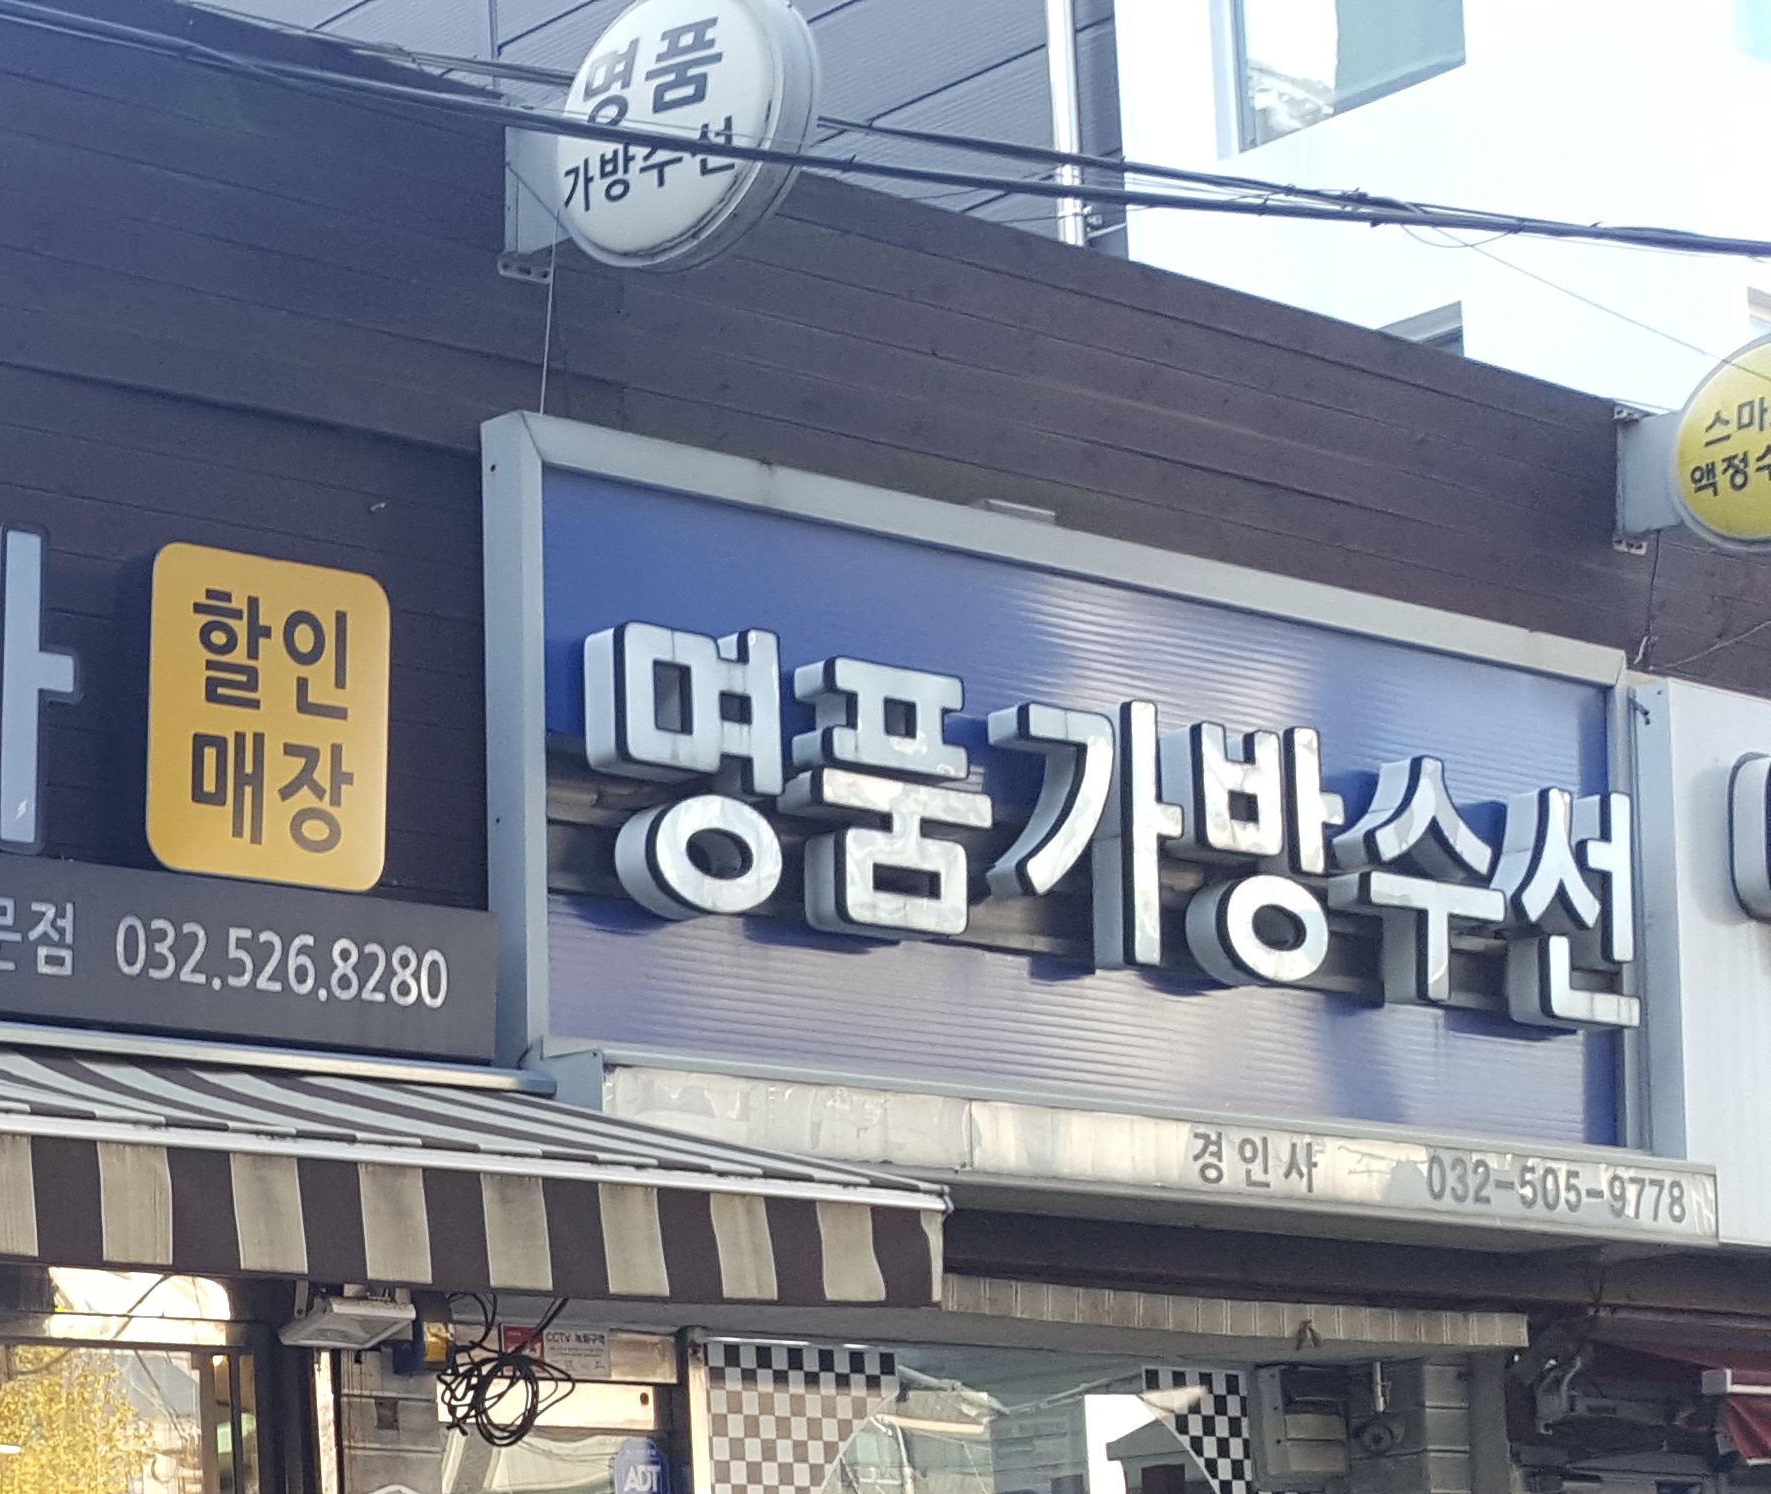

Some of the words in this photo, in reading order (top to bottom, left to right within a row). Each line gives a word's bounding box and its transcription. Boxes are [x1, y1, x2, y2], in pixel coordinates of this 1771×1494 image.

[583, 16, 723, 126] 명품
[564, 115, 735, 212] 가방수선
[1704, 397, 1771, 447] 스마
[192, 586, 352, 706] 할인
[191, 726, 357, 855] 매장
[582, 619, 1641, 1031] 명품가방수선
[115, 917, 450, 1015] 032.526.8280
[1425, 1148, 1687, 1228] 032-505-9778
[546, 1331, 571, 1343] CCTV
[623, 1464, 661, 1493] ADT
